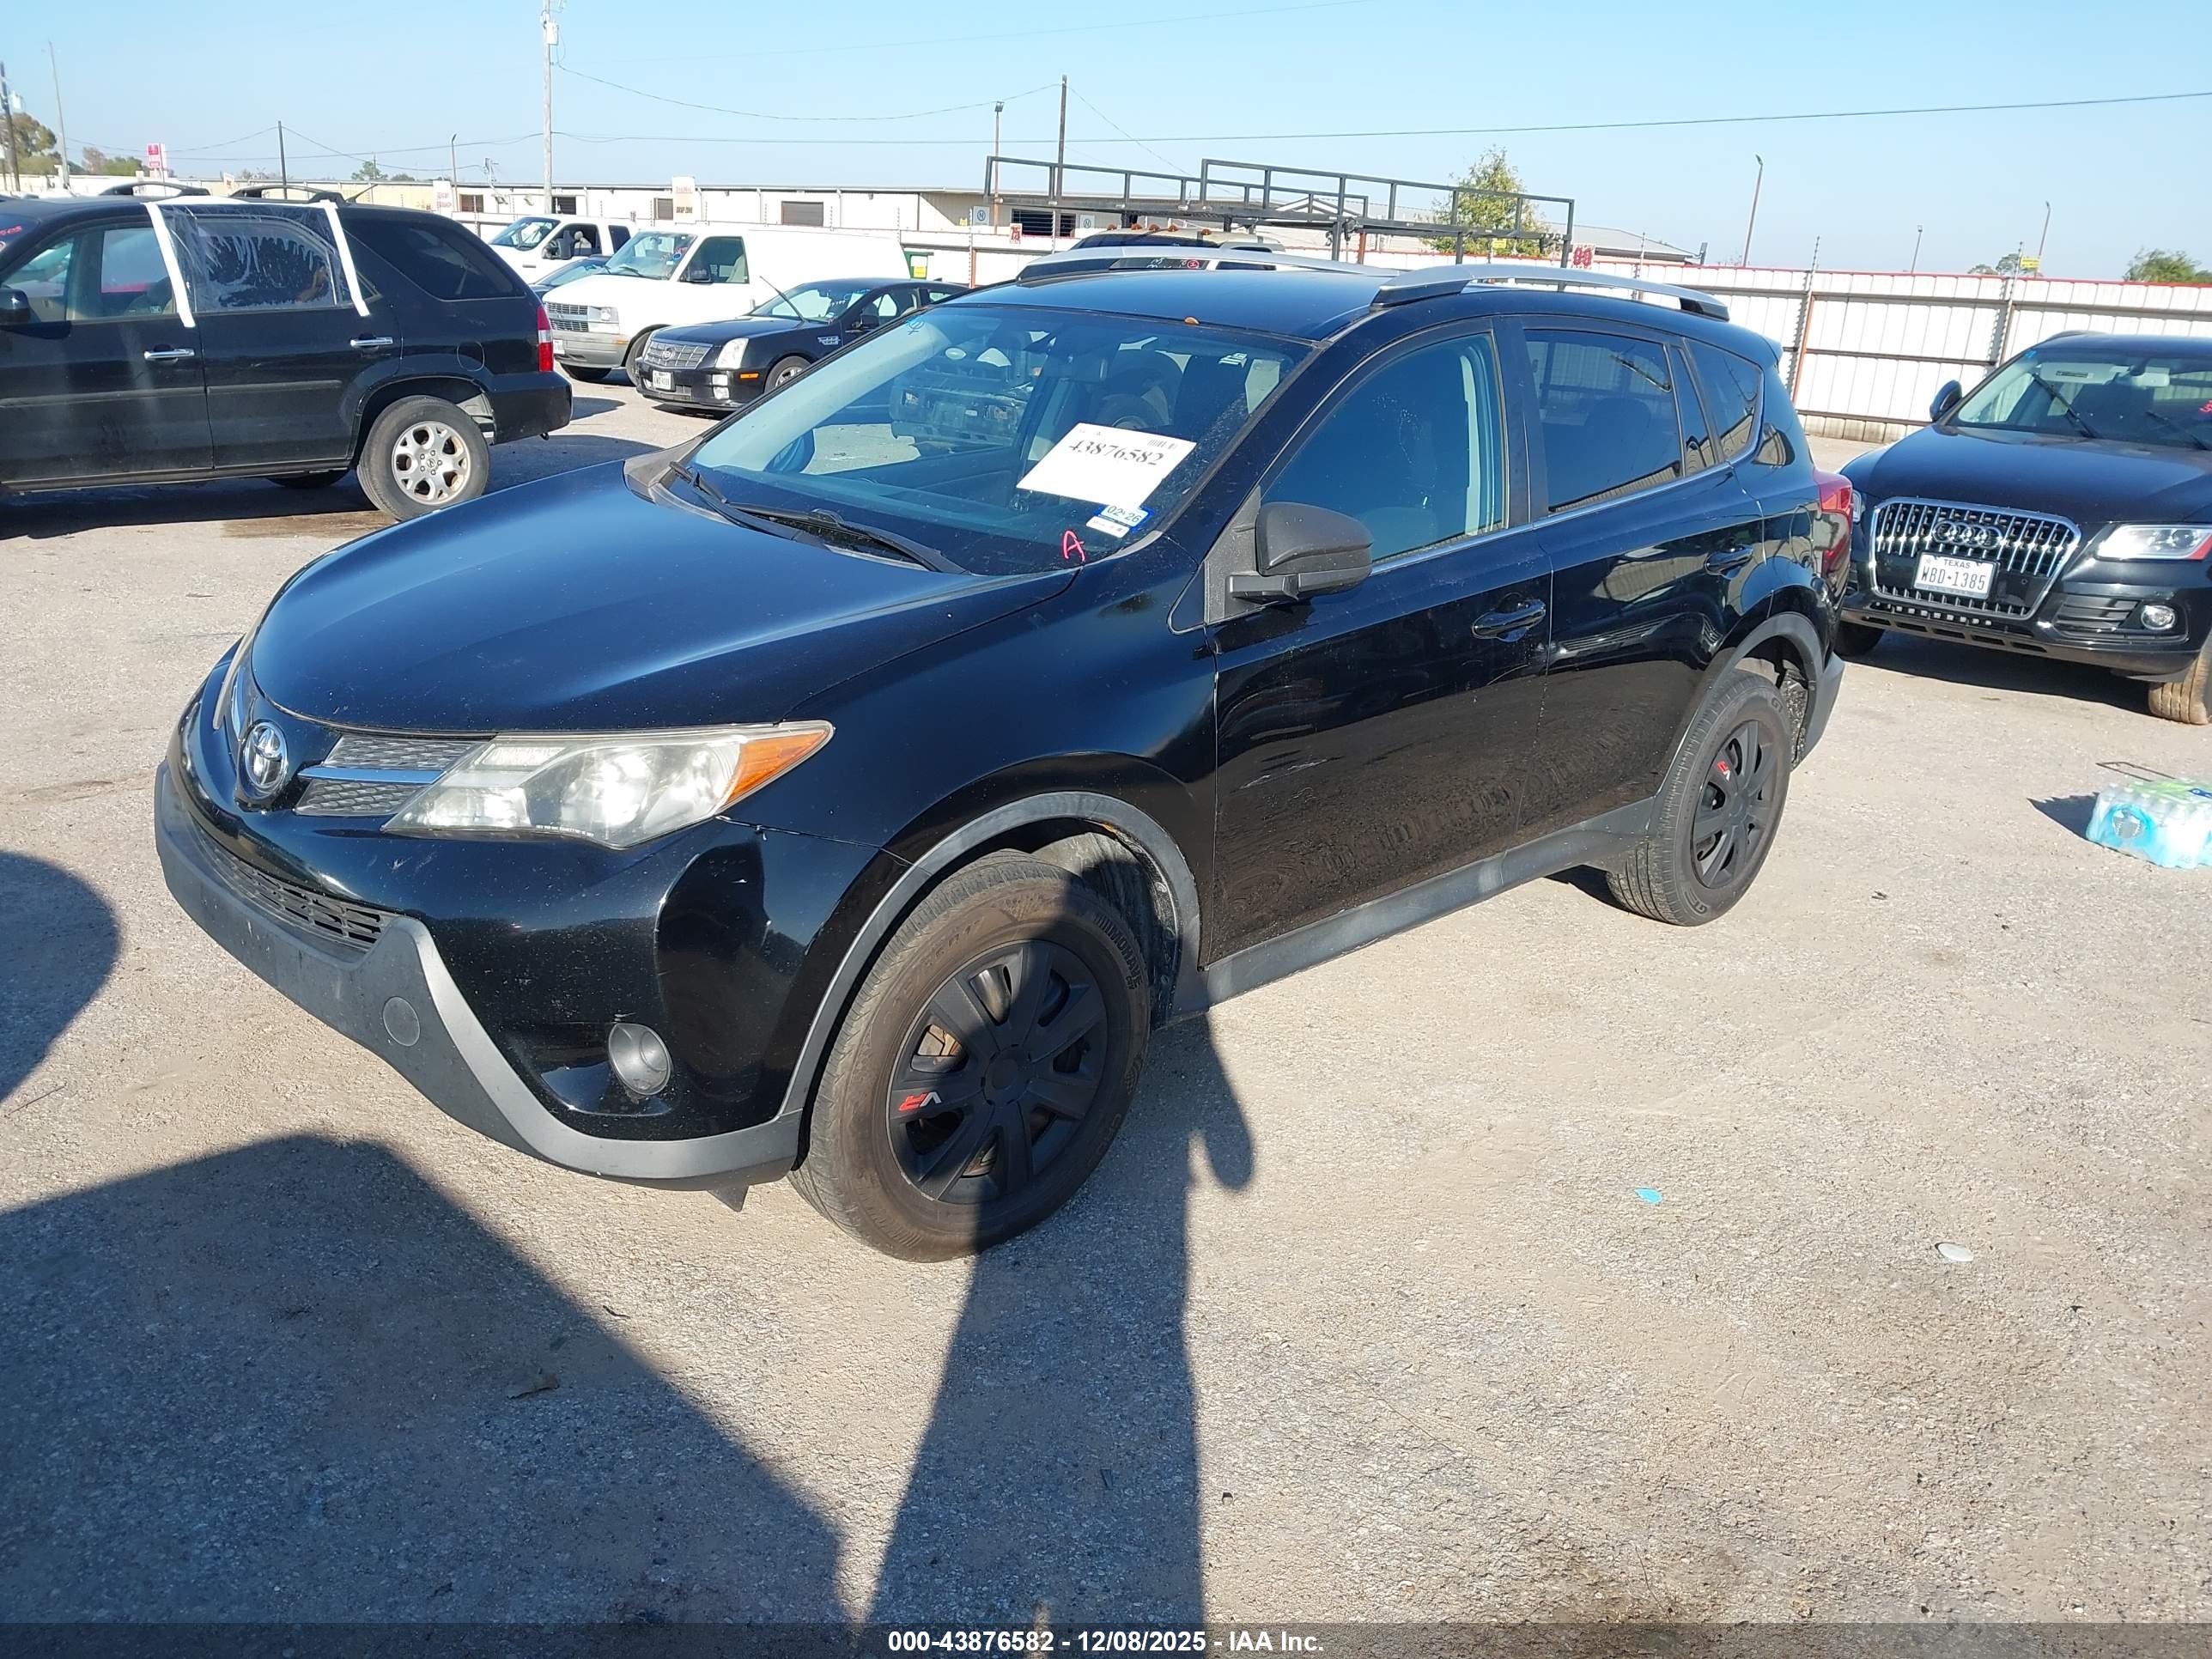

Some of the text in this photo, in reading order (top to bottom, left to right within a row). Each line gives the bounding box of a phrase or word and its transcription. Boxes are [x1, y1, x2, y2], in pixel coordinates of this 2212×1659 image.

[1068, 440, 1164, 465] 43876582
[1127, 512, 1143, 523] 26
[1062, 530, 1085, 562] A
[1943, 558, 1971, 568] TEXAS
